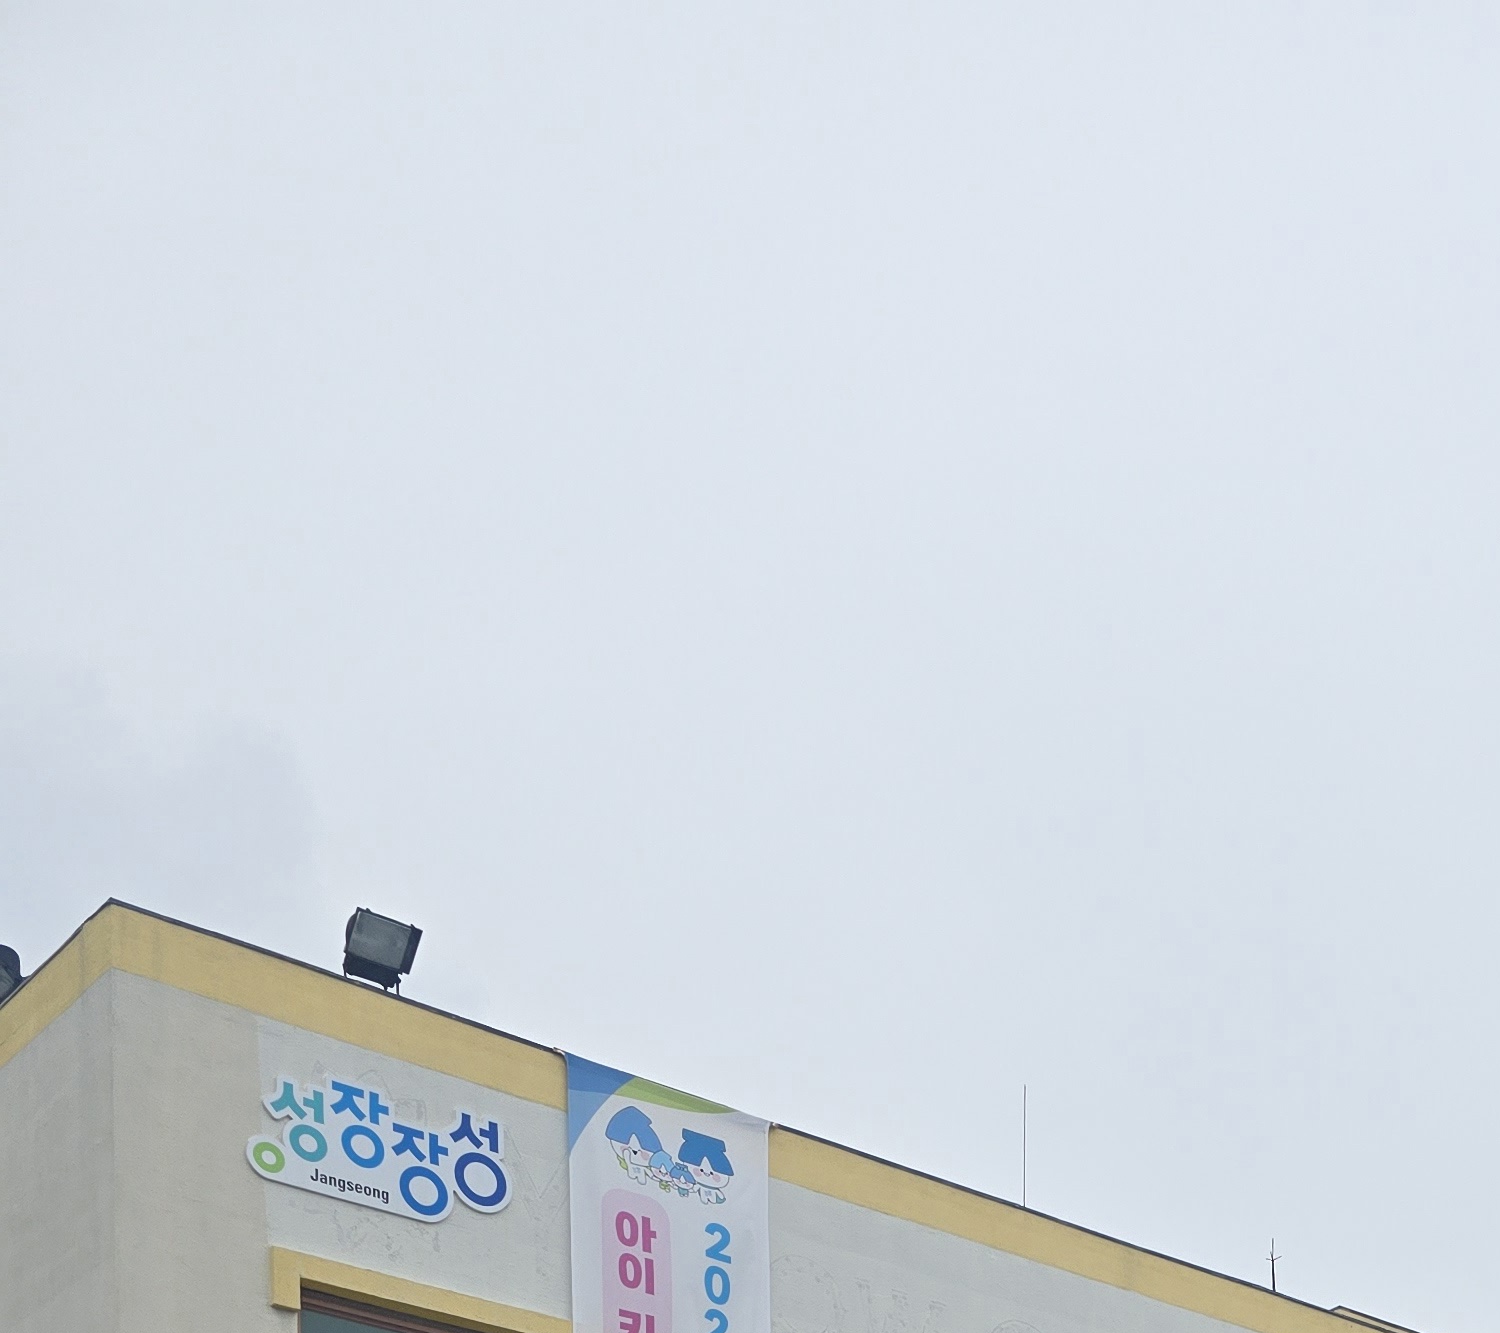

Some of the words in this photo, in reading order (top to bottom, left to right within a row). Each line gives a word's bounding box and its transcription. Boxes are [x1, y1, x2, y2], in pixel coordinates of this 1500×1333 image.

[271, 1080, 507, 1215] 성장장성
[310, 1168, 389, 1203] Jangseong
[615, 1210, 656, 1295] 아이
